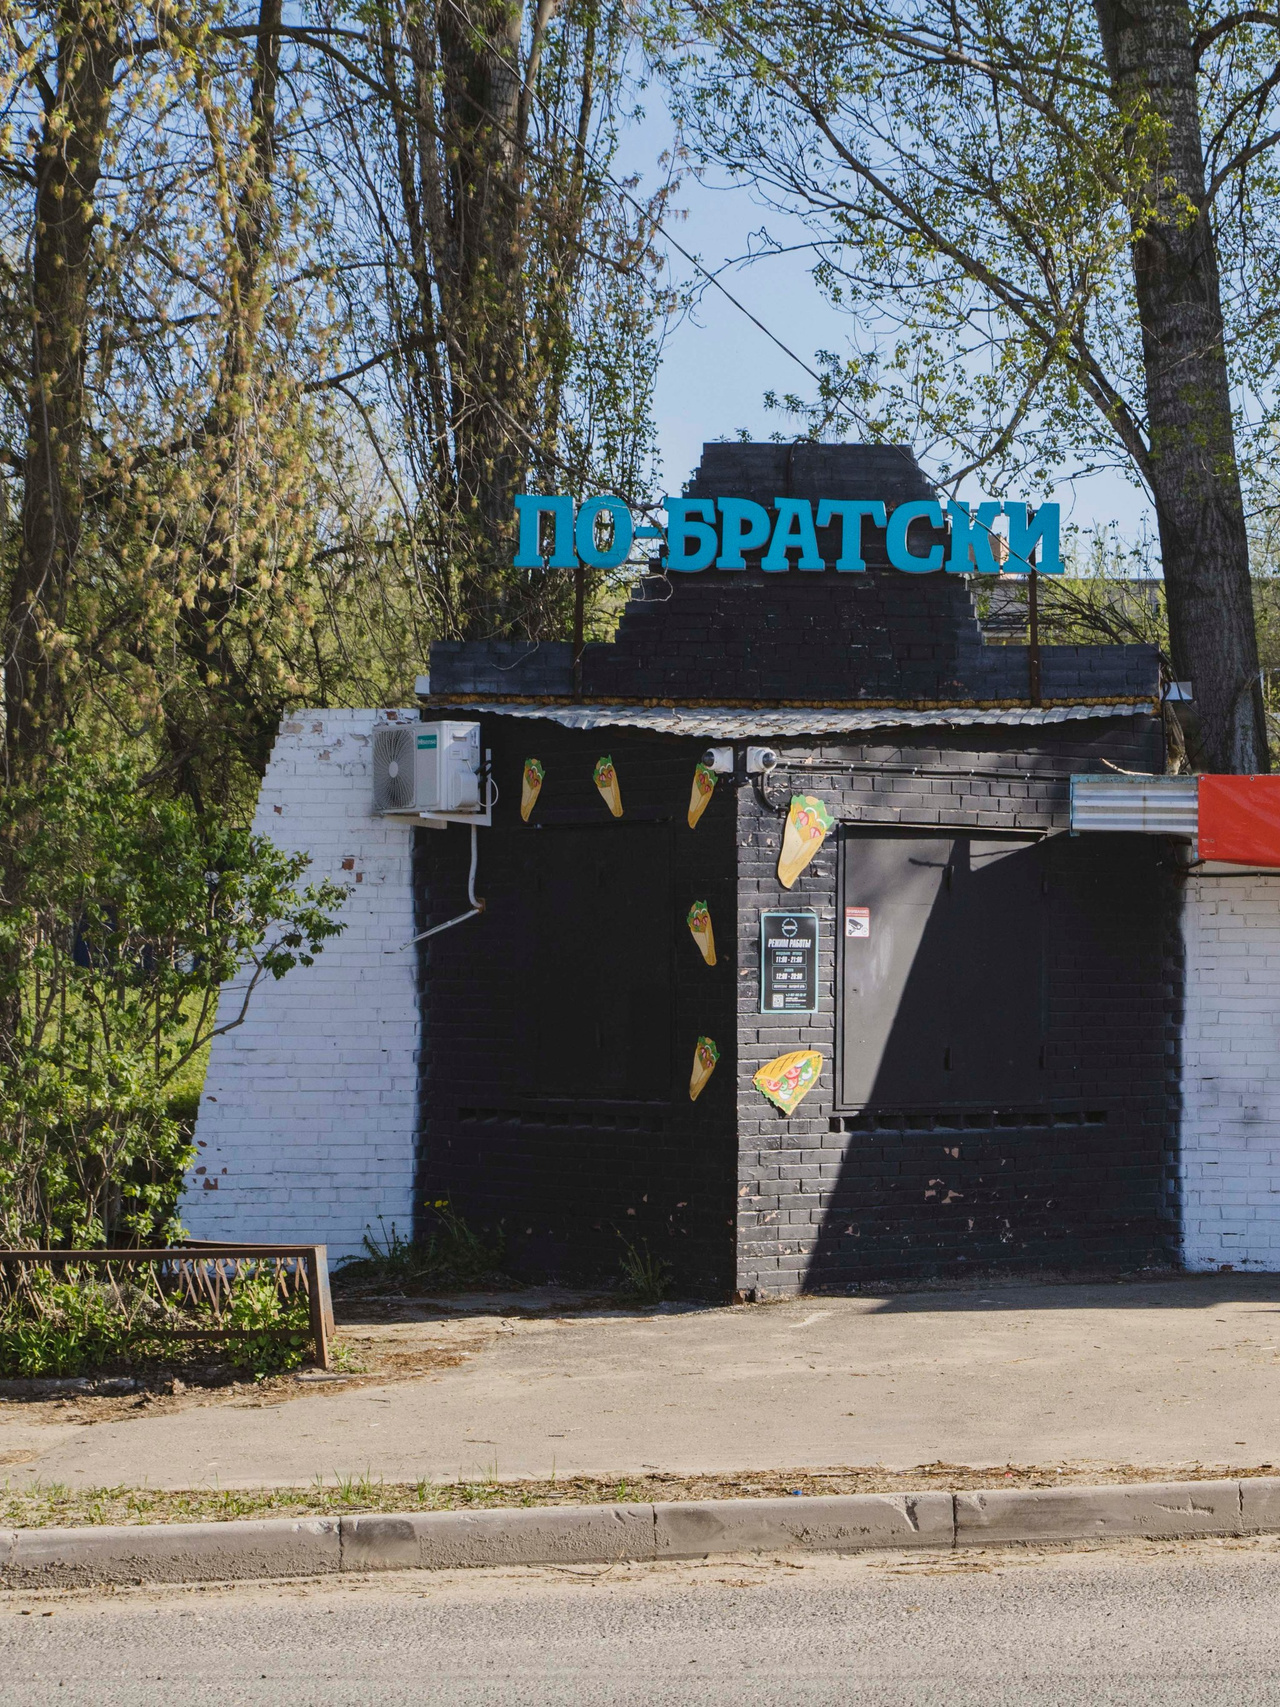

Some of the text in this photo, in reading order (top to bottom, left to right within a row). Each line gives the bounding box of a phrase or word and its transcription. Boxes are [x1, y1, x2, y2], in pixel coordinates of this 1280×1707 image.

[513, 494, 1065, 574] ПО-БРАТСКИ
[768, 939, 811, 948] РЕЖИМ РАБОТЫ
